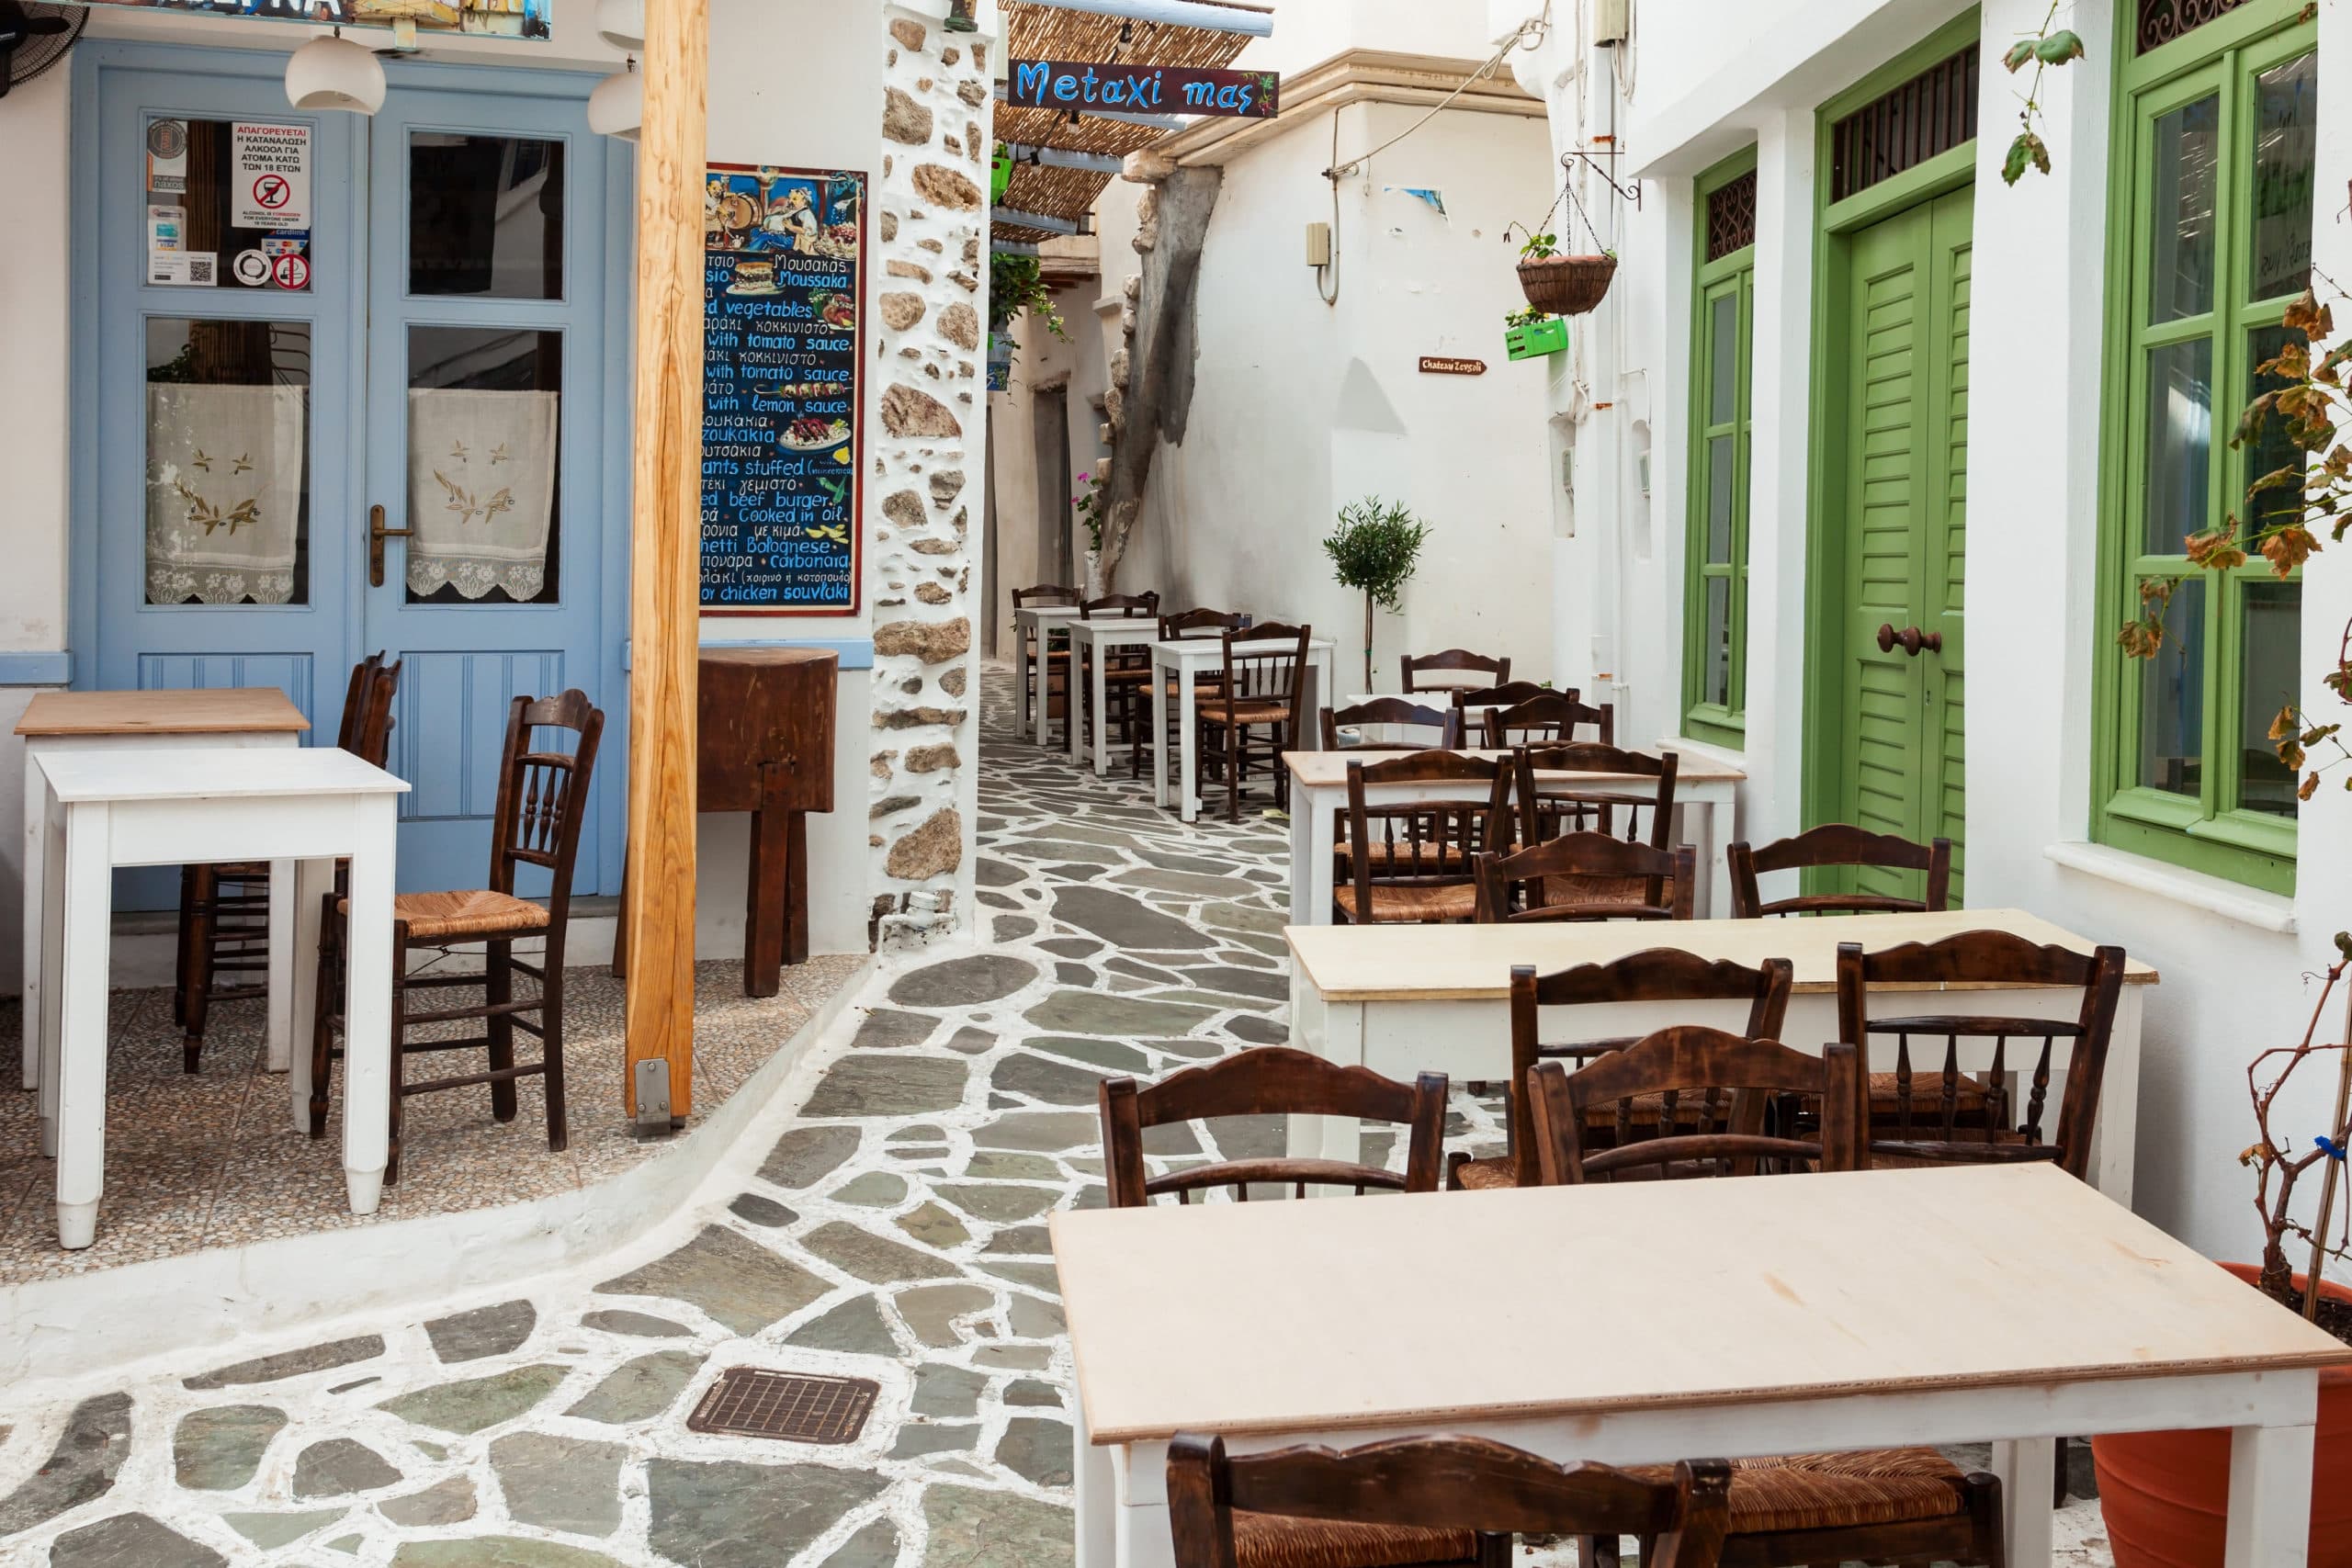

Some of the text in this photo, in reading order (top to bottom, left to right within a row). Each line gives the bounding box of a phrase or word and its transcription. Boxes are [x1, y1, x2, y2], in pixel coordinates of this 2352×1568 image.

[1017, 62, 1162, 108] Metaxi
[238, 126, 306, 136] ΑΠΑΓΟΡΕΥΕΤΑΙ
[246, 136, 306, 145] ΚΑΤΑΝΑΛΩΣΗ
[244, 145, 282, 153] ΑΛΚΟΟΛ
[276, 155, 300, 164] ΚΑΤΩ
[243, 163, 262, 171] ΤΩΝ
[277, 164, 300, 173] ΕΤΩΝ
[777, 270, 847, 288] Moussaka
[726, 300, 812, 320] vegetables
[707, 332, 738, 347] with
[747, 333, 796, 349] tomato
[706, 364, 733, 378] with
[741, 364, 793, 380] tomato
[708, 396, 739, 411] with
[752, 394, 795, 412] lemon
[745, 457, 804, 475] stuffed
[729, 491, 764, 506] beef
[739, 507, 796, 523] Cooked
[801, 509, 813, 522] in
[754, 525, 768, 541] με
[747, 536, 831, 556] Bolognese
[701, 581, 848, 600] or chicken souvlaki
